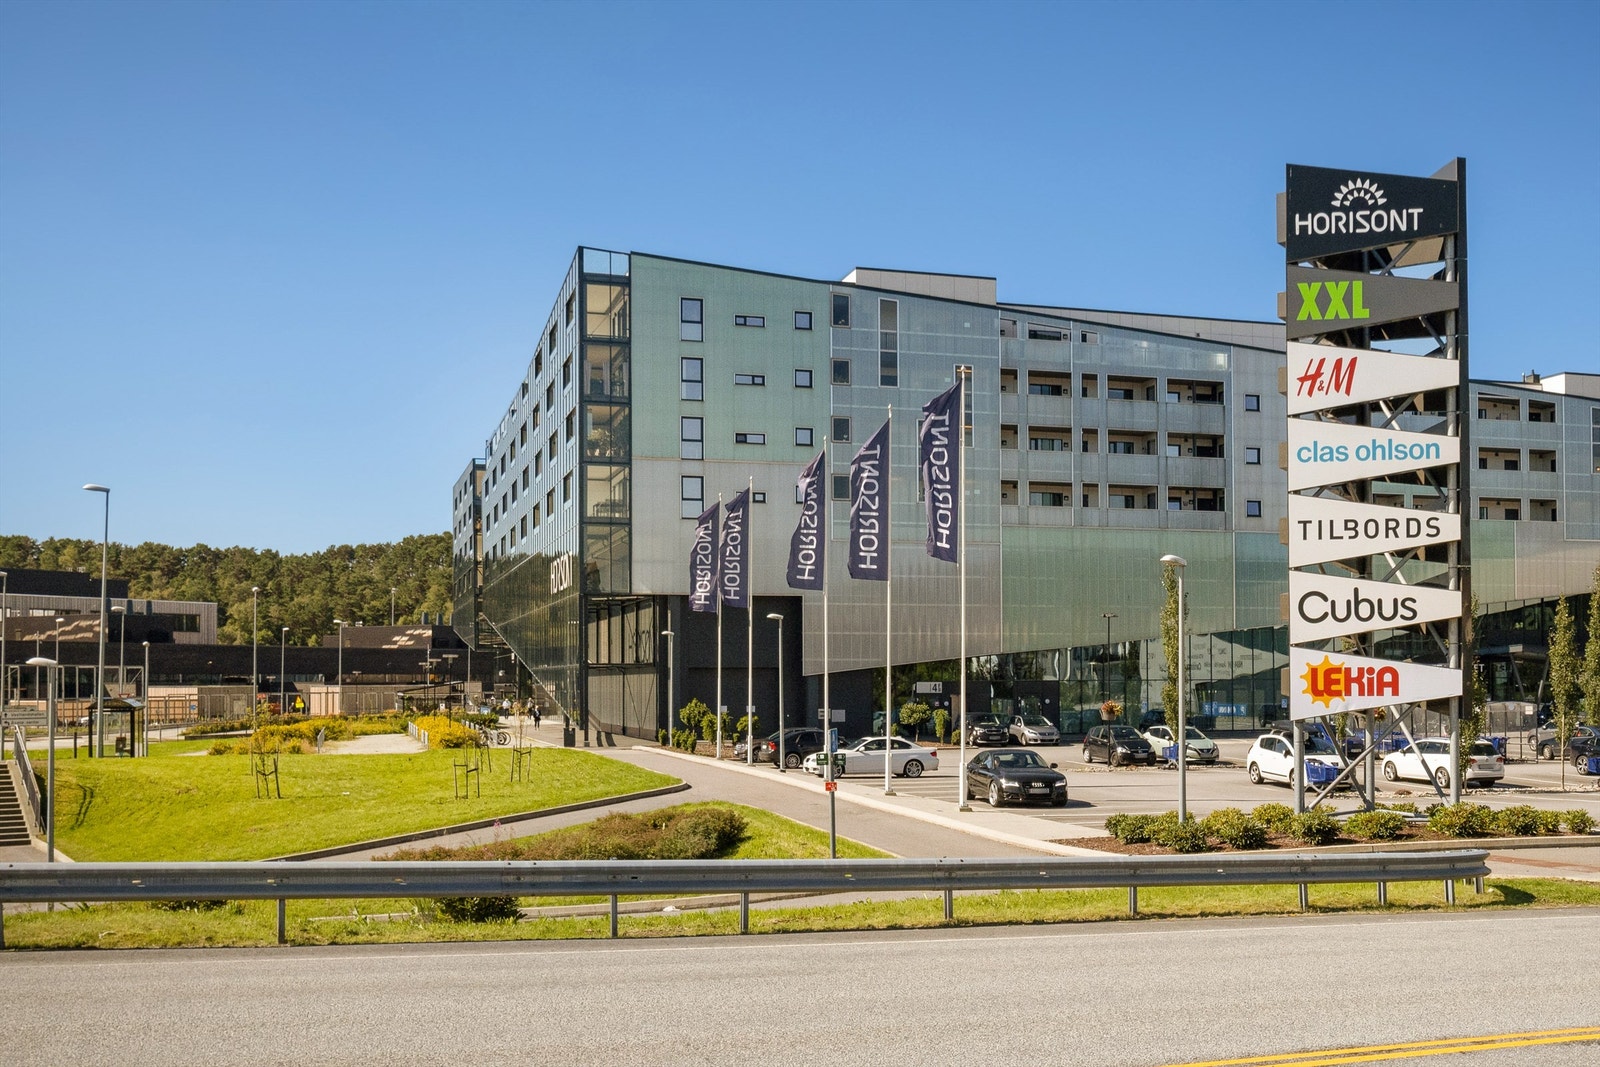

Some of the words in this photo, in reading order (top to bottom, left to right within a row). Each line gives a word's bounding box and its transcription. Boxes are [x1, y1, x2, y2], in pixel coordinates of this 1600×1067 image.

[1294, 207, 1424, 236] HORISONT
[1296, 280, 1370, 321] XXL
[1296, 356, 1358, 398] H&M
[1296, 440, 1349, 463] clas
[1355, 438, 1441, 461] ohlson
[1297, 516, 1441, 541] TILBORDS
[1298, 586, 1418, 624] Cubus
